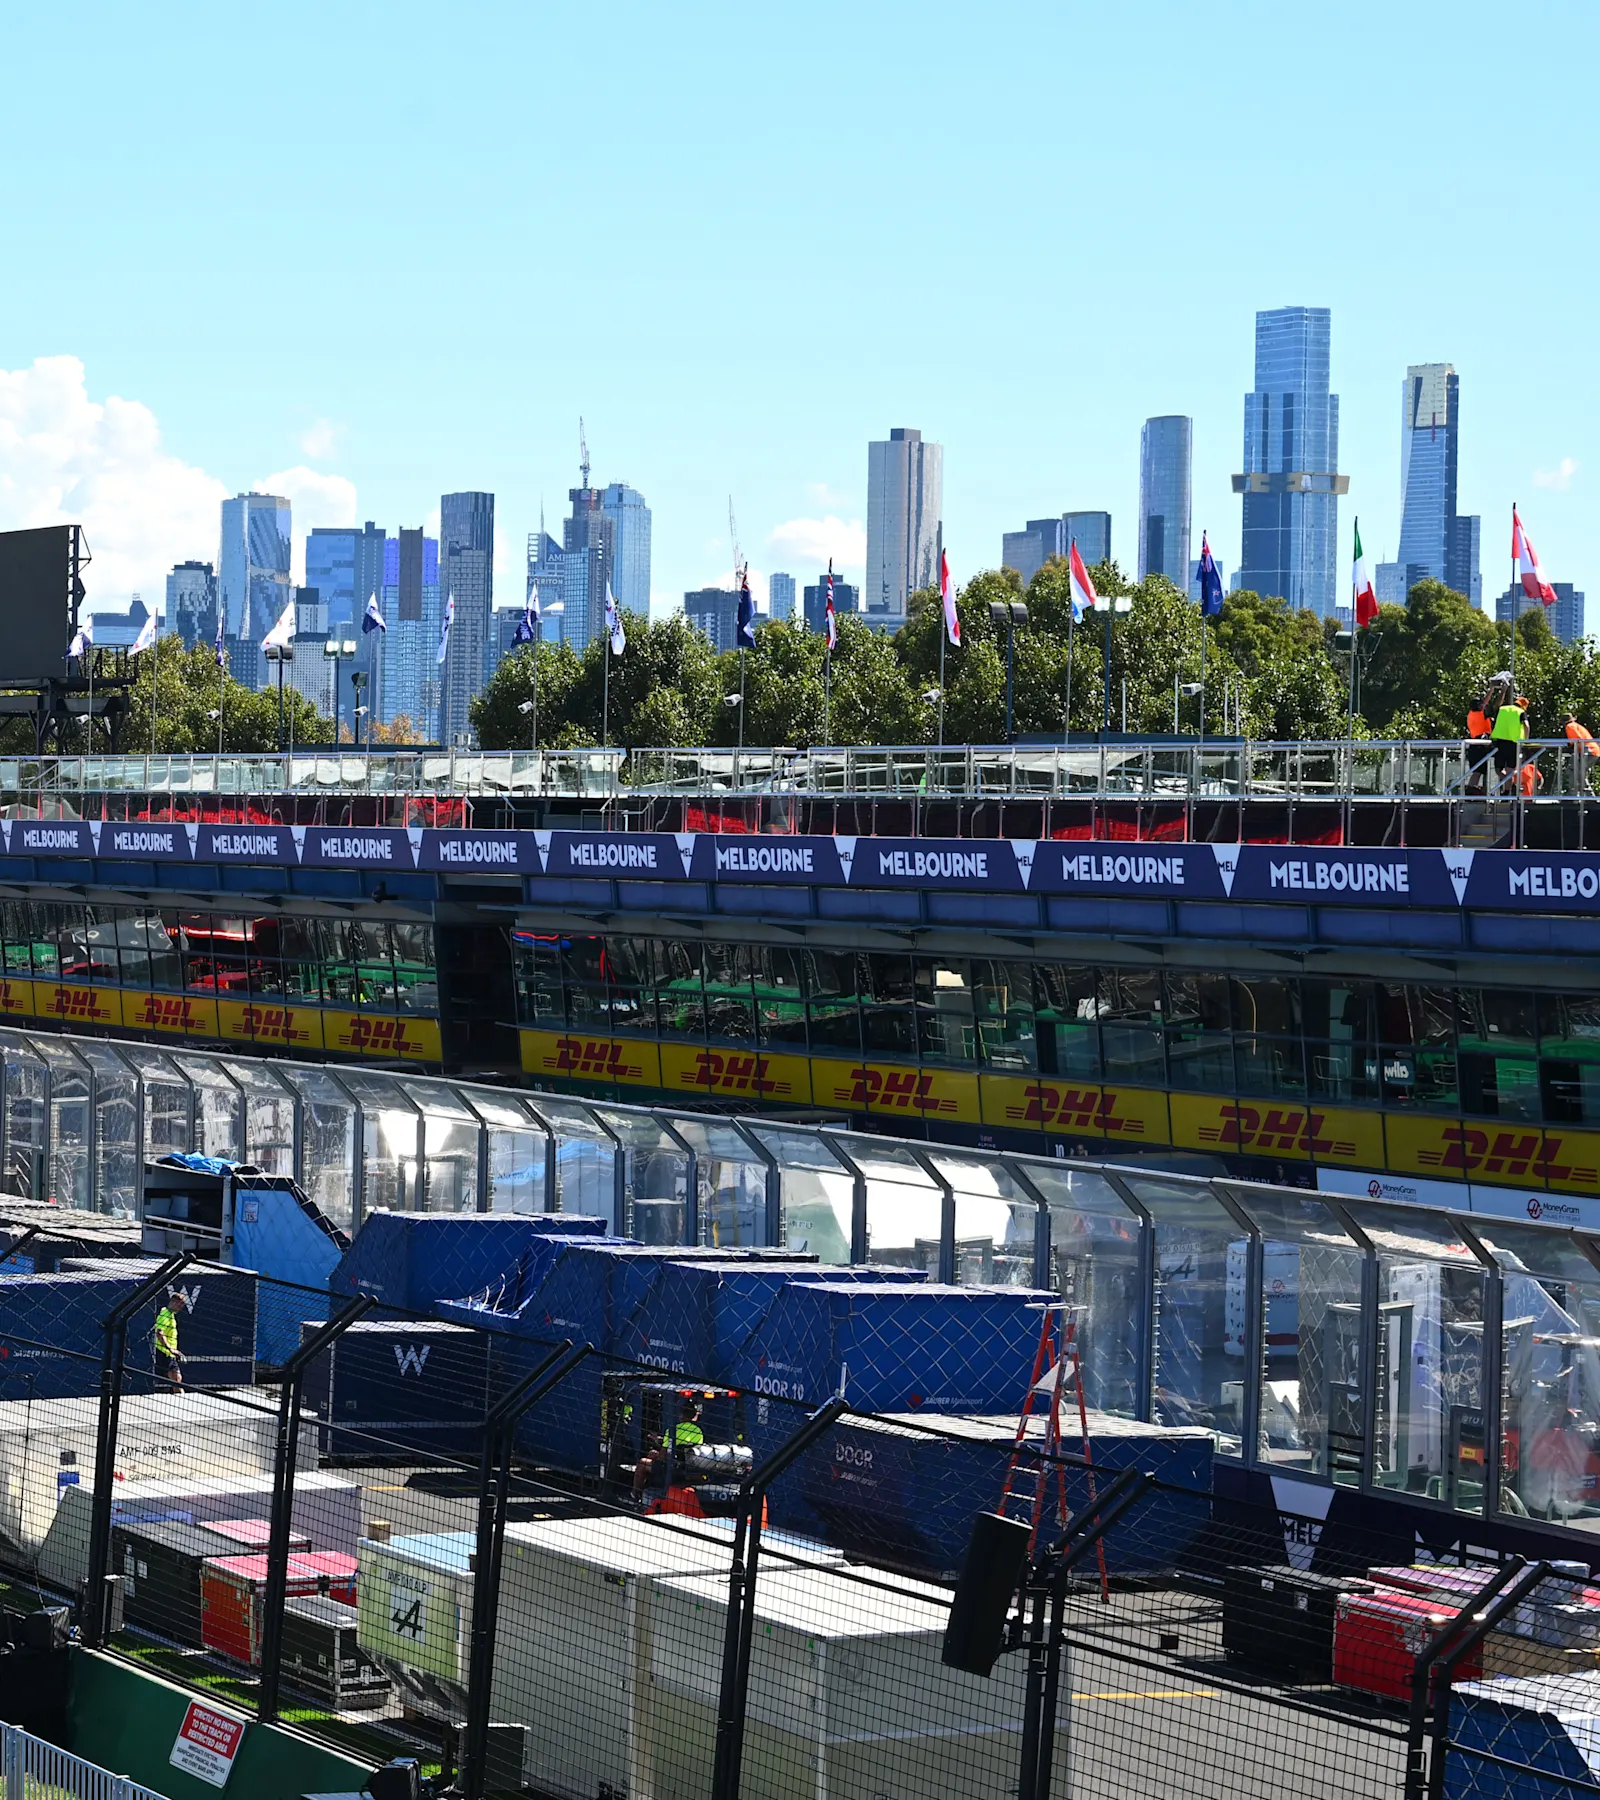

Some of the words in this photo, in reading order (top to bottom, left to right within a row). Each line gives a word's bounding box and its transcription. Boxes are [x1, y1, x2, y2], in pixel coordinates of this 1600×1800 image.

[24, 830, 79, 849] MELBOURNE
[113, 832, 174, 852] MELBOURNE
[212, 835, 278, 855] MELBOURNE
[321, 838, 392, 859] MELBOURNE
[439, 841, 517, 863] MELBOURNE
[570, 844, 657, 867] MELBOURNE
[679, 847, 693, 857] MEL
[717, 848, 815, 872] MELBOURNE
[839, 851, 853, 862] MEL
[1017, 856, 1032, 867] MEL
[880, 852, 988, 878] MELBOURNE
[1063, 856, 1185, 885] MELBOURNE
[1219, 861, 1235, 872] MEL
[1271, 862, 1409, 892] MELBOURNE
[1449, 867, 1468, 878] MEL
[1509, 868, 1600, 898] MELBO
[54, 989, 103, 1017] DHL
[144, 998, 197, 1028] DHL
[241, 1008, 299, 1039] DHL
[349, 1019, 412, 1051] DHL
[556, 1040, 629, 1076] DHL
[695, 1053, 777, 1092] DHL
[849, 1068, 941, 1111] DHL
[1023, 1086, 1126, 1131] DHL
[1218, 1105, 1334, 1153] DHL
[1055, 1143, 1065, 1157] 10
[1441, 1127, 1573, 1180] DHL
[1382, 1183, 1417, 1195] MoneyGram
[1543, 1202, 1580, 1214] MoneyGram
[394, 1344, 431, 1376] W
[637, 1353, 669, 1370] DOOR
[755, 1375, 790, 1400] DOOR
[791, 1383, 805, 1401] 10
[923, 1396, 950, 1405] SAUBER
[161, 1445, 182, 1455] SMS
[835, 1443, 874, 1468] DOOR
[191, 1719, 199, 1728] TO
[199, 1722, 209, 1733] THE
[208, 1726, 224, 1739] TRACK
[223, 1733, 232, 1743] OR
[193, 1708, 214, 1722] STRICTLY
[213, 1718, 222, 1726] NO
[221, 1720, 238, 1733] ENTRY
[187, 1728, 215, 1746] RESTRICTED
[213, 1741, 228, 1753] AREA
